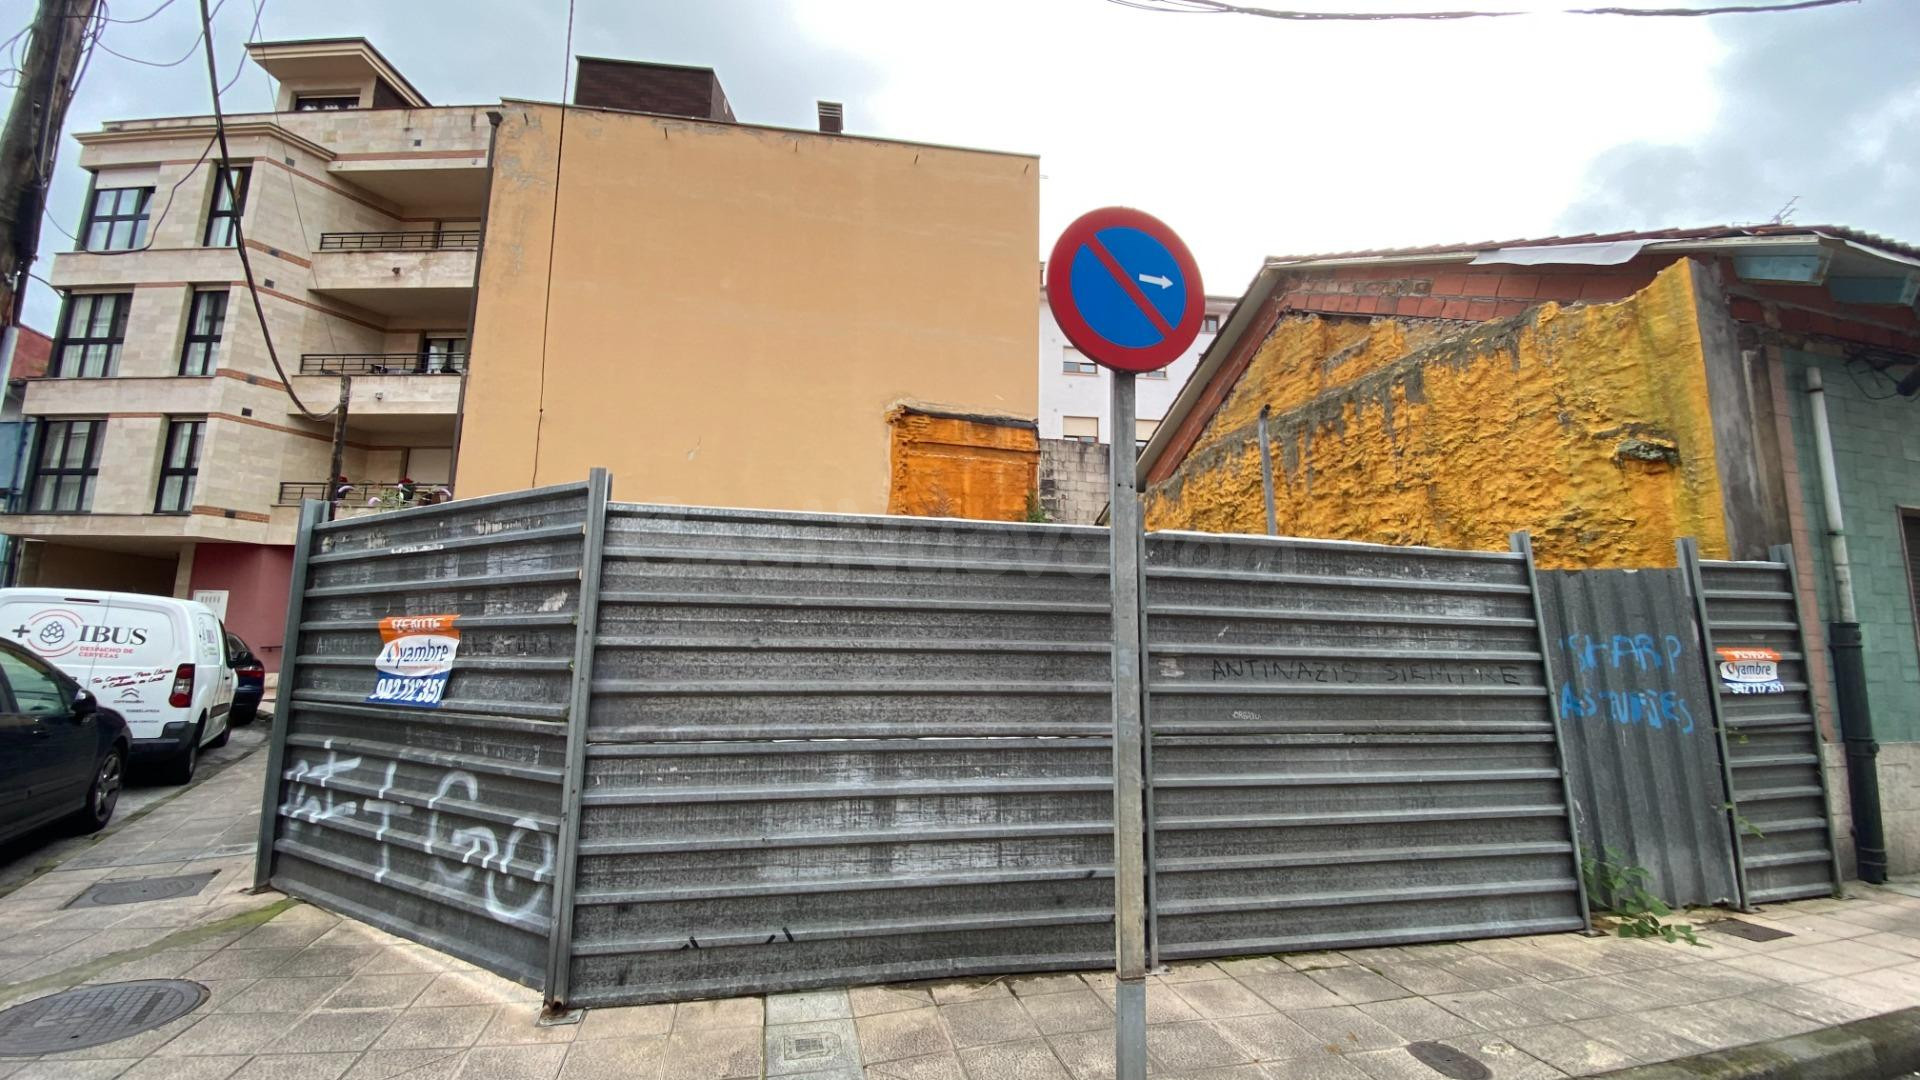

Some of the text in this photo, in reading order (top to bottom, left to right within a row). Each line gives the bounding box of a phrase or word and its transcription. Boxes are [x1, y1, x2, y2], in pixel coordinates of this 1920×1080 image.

[79, 624, 148, 646] IBUS
[79, 646, 122, 654] DESPACHO
[1212, 658, 1359, 684] ANTINAZIS
